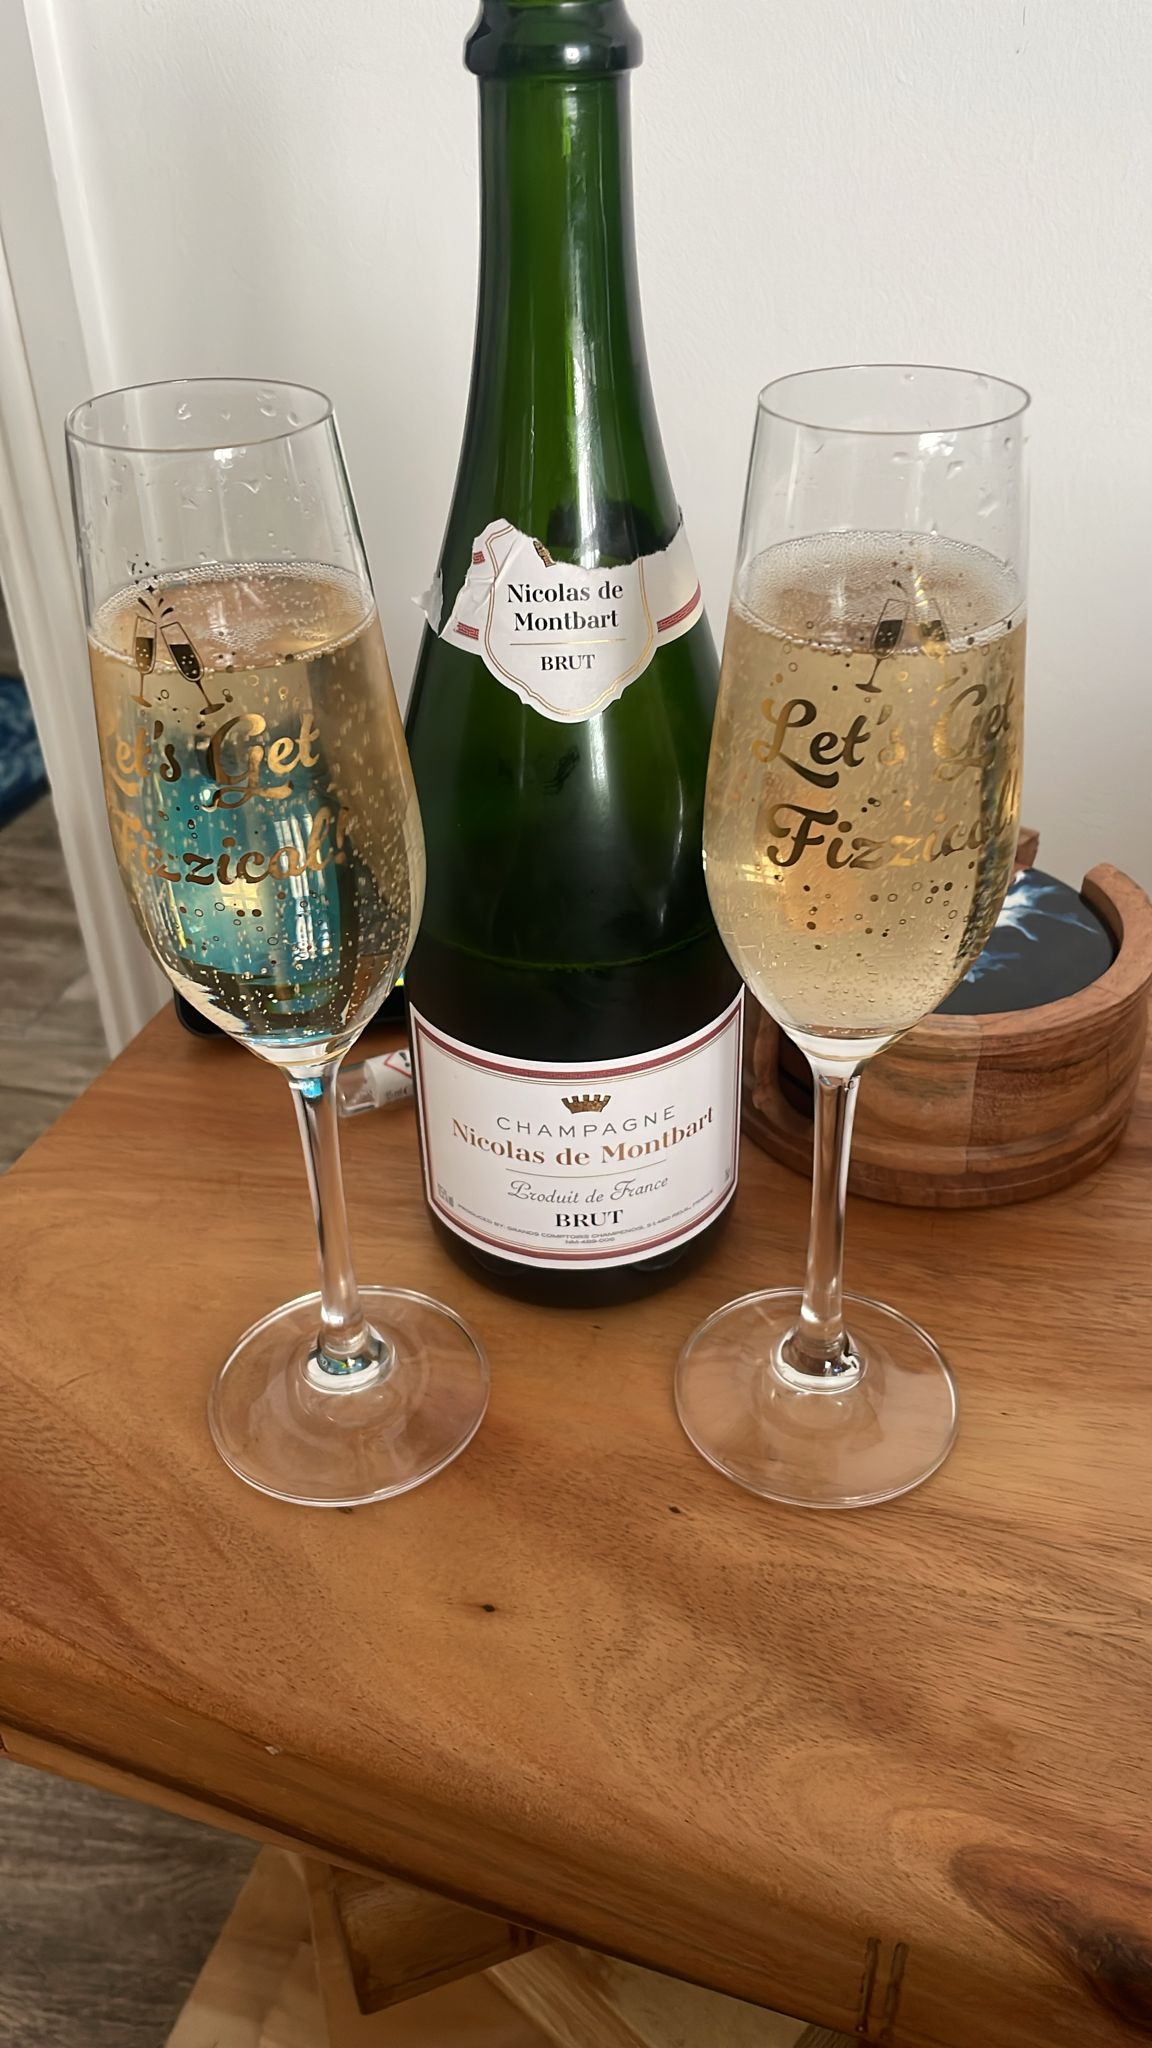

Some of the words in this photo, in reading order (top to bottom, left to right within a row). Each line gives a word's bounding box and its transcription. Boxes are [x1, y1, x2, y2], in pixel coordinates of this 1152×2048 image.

[507, 583, 591, 603] Nicolas
[598, 581, 624, 599] de
[514, 610, 619, 631] Montbart
[540, 654, 595, 671] BRUT
[751, 699, 905, 789] Let's
[933, 676, 1015, 782] Get
[201, 713, 321, 811] Get
[496, 1105, 675, 1138] CHAMPAGNE
[451, 1117, 545, 1164] Nicolas
[555, 1148, 590, 1166] de
[601, 1106, 713, 1163] Montbart
[507, 1180, 579, 1204] Produit
[585, 1189, 604, 1204] de
[610, 1178, 668, 1200] France
[556, 1209, 624, 1227] BRUT
